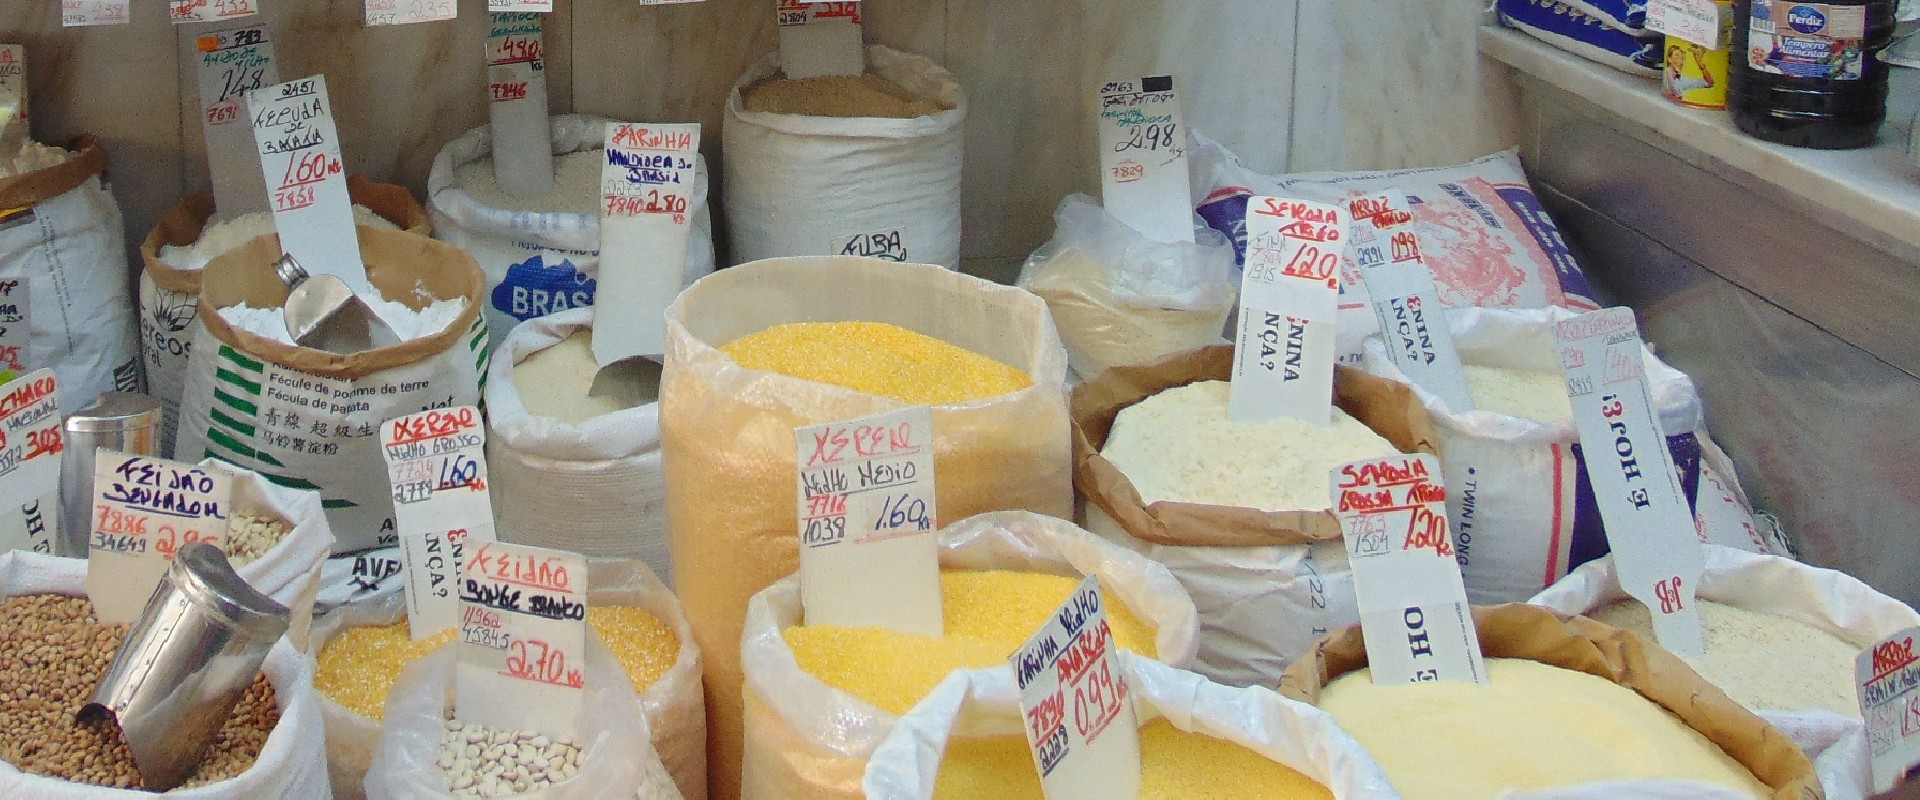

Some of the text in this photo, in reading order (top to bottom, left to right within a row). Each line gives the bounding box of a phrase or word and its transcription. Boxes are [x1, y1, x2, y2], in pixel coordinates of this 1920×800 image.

[1788, 13, 1823, 27] Perdiz
[1780, 45, 1831, 58] Alimentar
[1784, 37, 1826, 50] Tempero
[282, 81, 315, 96] 2451
[269, 372, 311, 391] Fécule
[314, 382, 329, 395] de
[380, 384, 397, 395] de
[399, 379, 429, 394] terre
[267, 387, 309, 406] Fécula
[312, 398, 327, 410] de
[803, 517, 846, 544] 1038
[1459, 480, 1478, 566] TWIN LONG
[424, 533, 449, 598] NÇA?
[463, 623, 510, 650] 45845
